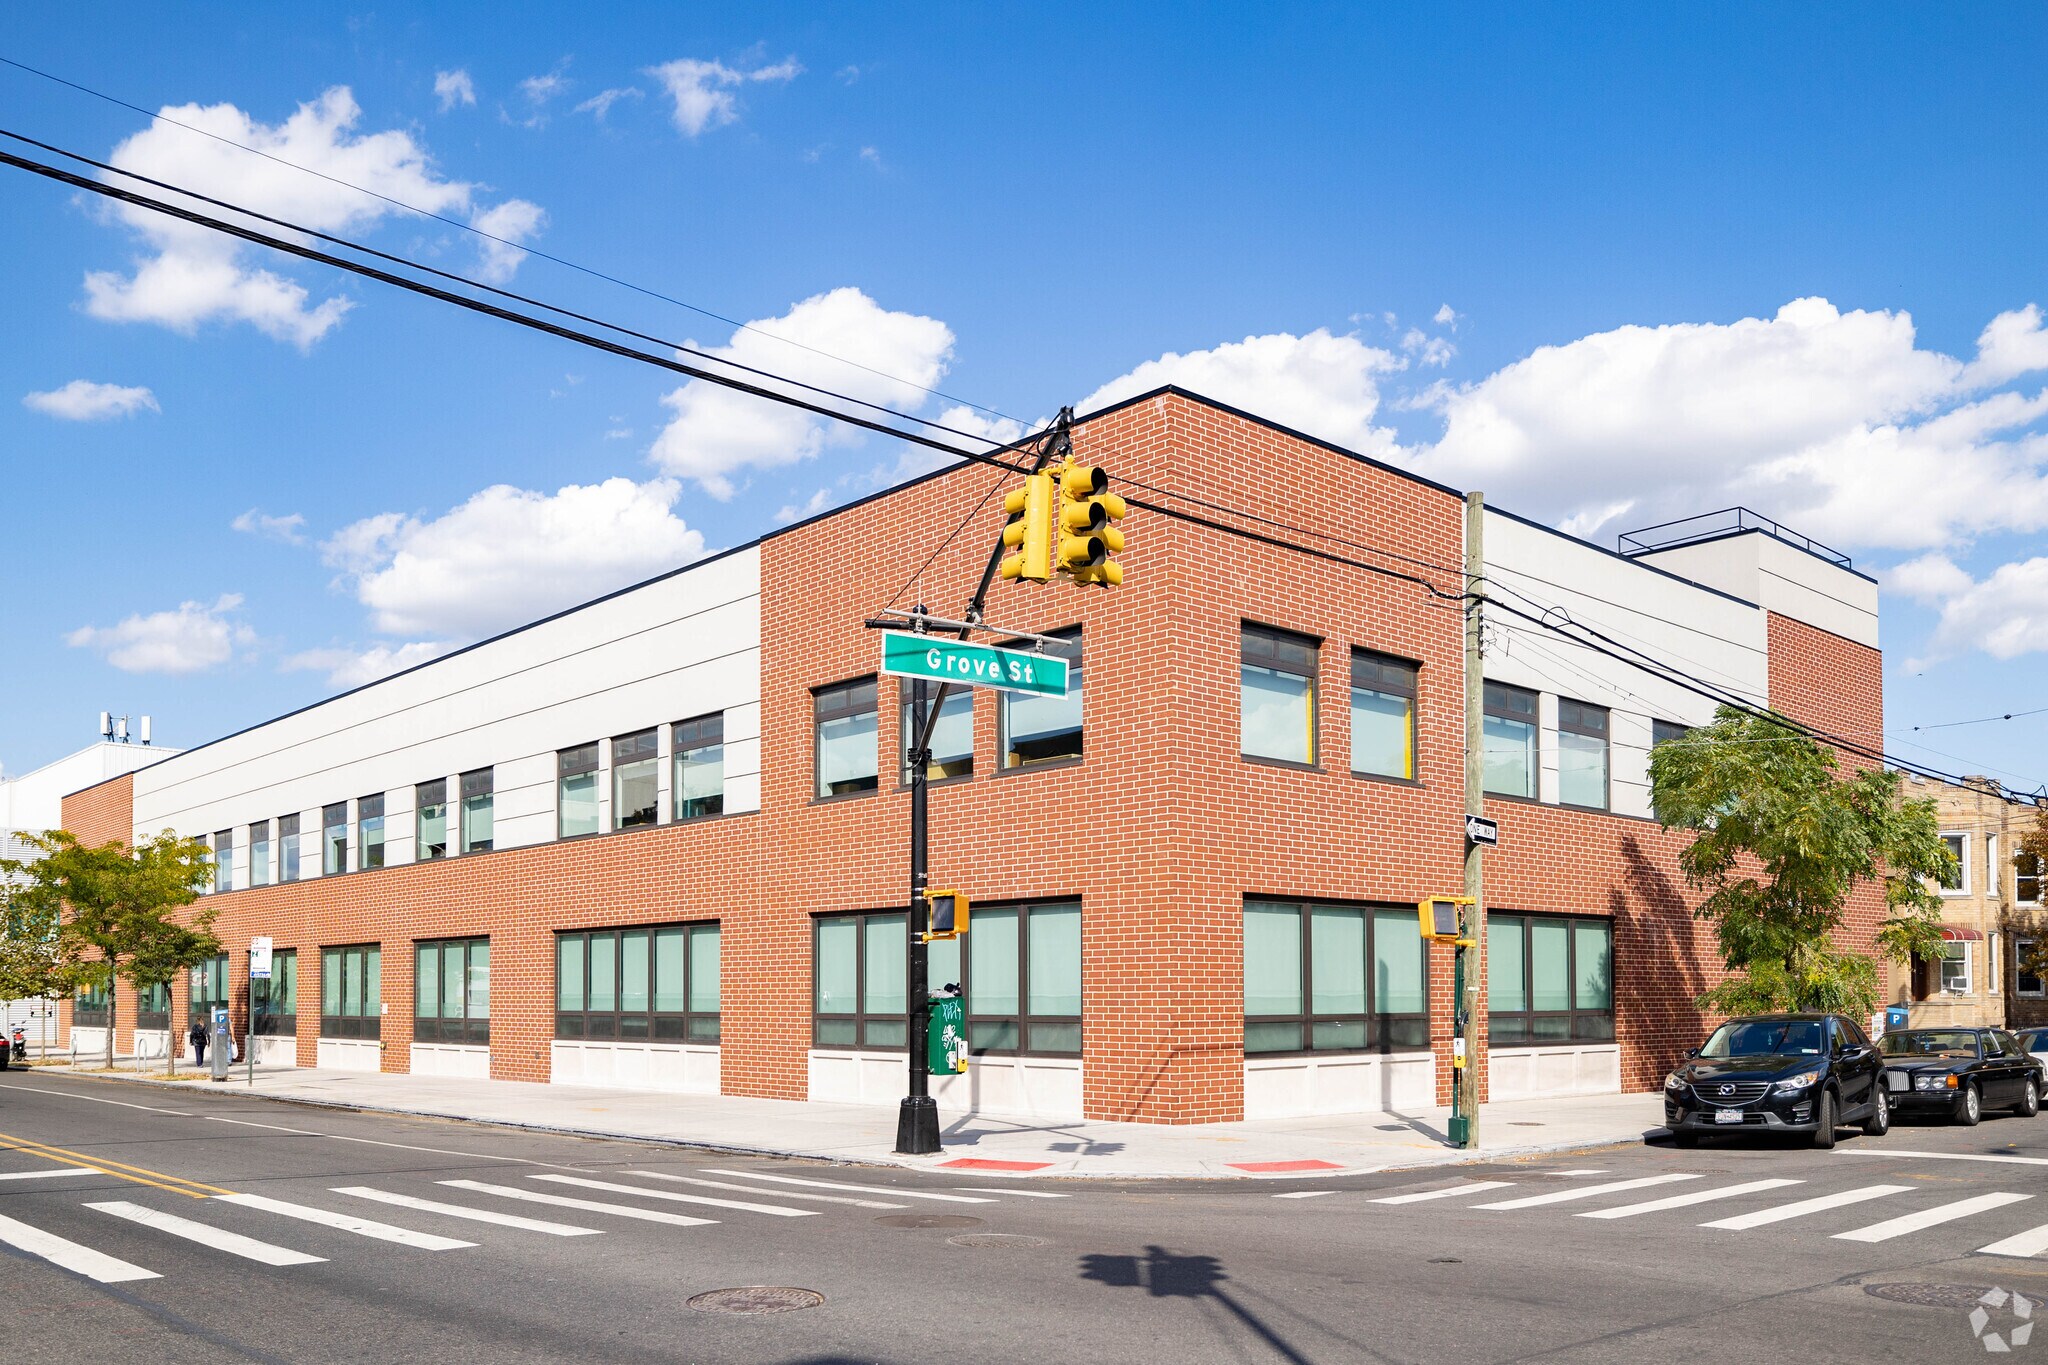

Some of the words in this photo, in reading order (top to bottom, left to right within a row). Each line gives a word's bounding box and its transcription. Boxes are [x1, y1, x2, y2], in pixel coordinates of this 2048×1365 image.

[926, 648, 1000, 678] Grove
[1009, 660, 1033, 684] St
[219, 1015, 225, 1023] P
[1893, 1014, 1900, 1024] P
